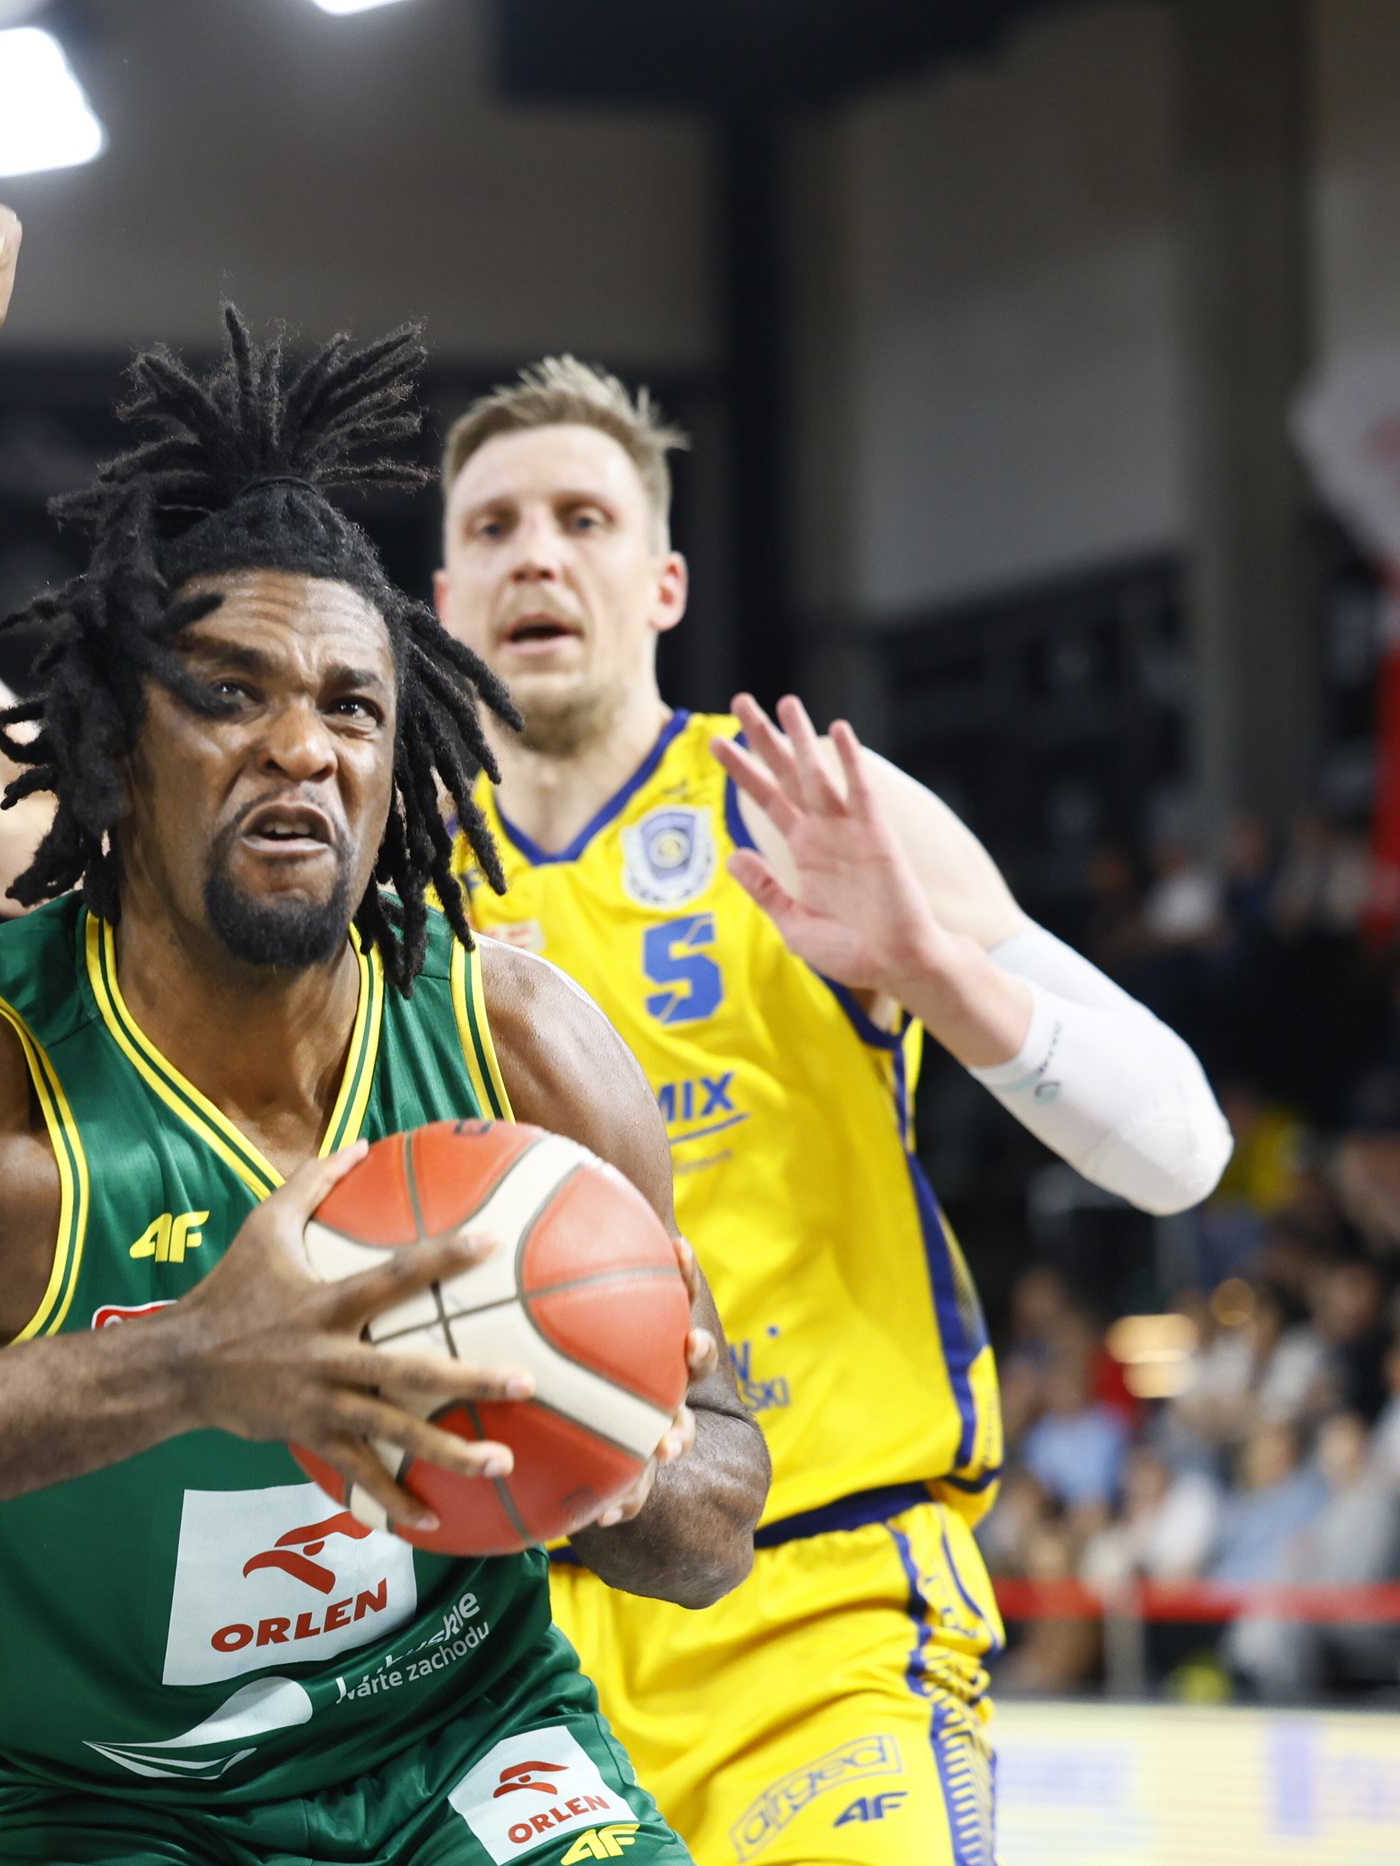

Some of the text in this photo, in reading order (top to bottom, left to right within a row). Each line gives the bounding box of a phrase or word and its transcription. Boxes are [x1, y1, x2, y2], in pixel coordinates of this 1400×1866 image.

[643, 911, 725, 1026] 5
[211, 1577, 388, 1653] ORLEN
[406, 1622, 490, 1681] zachodu
[508, 1795, 612, 1844] ORLEN
